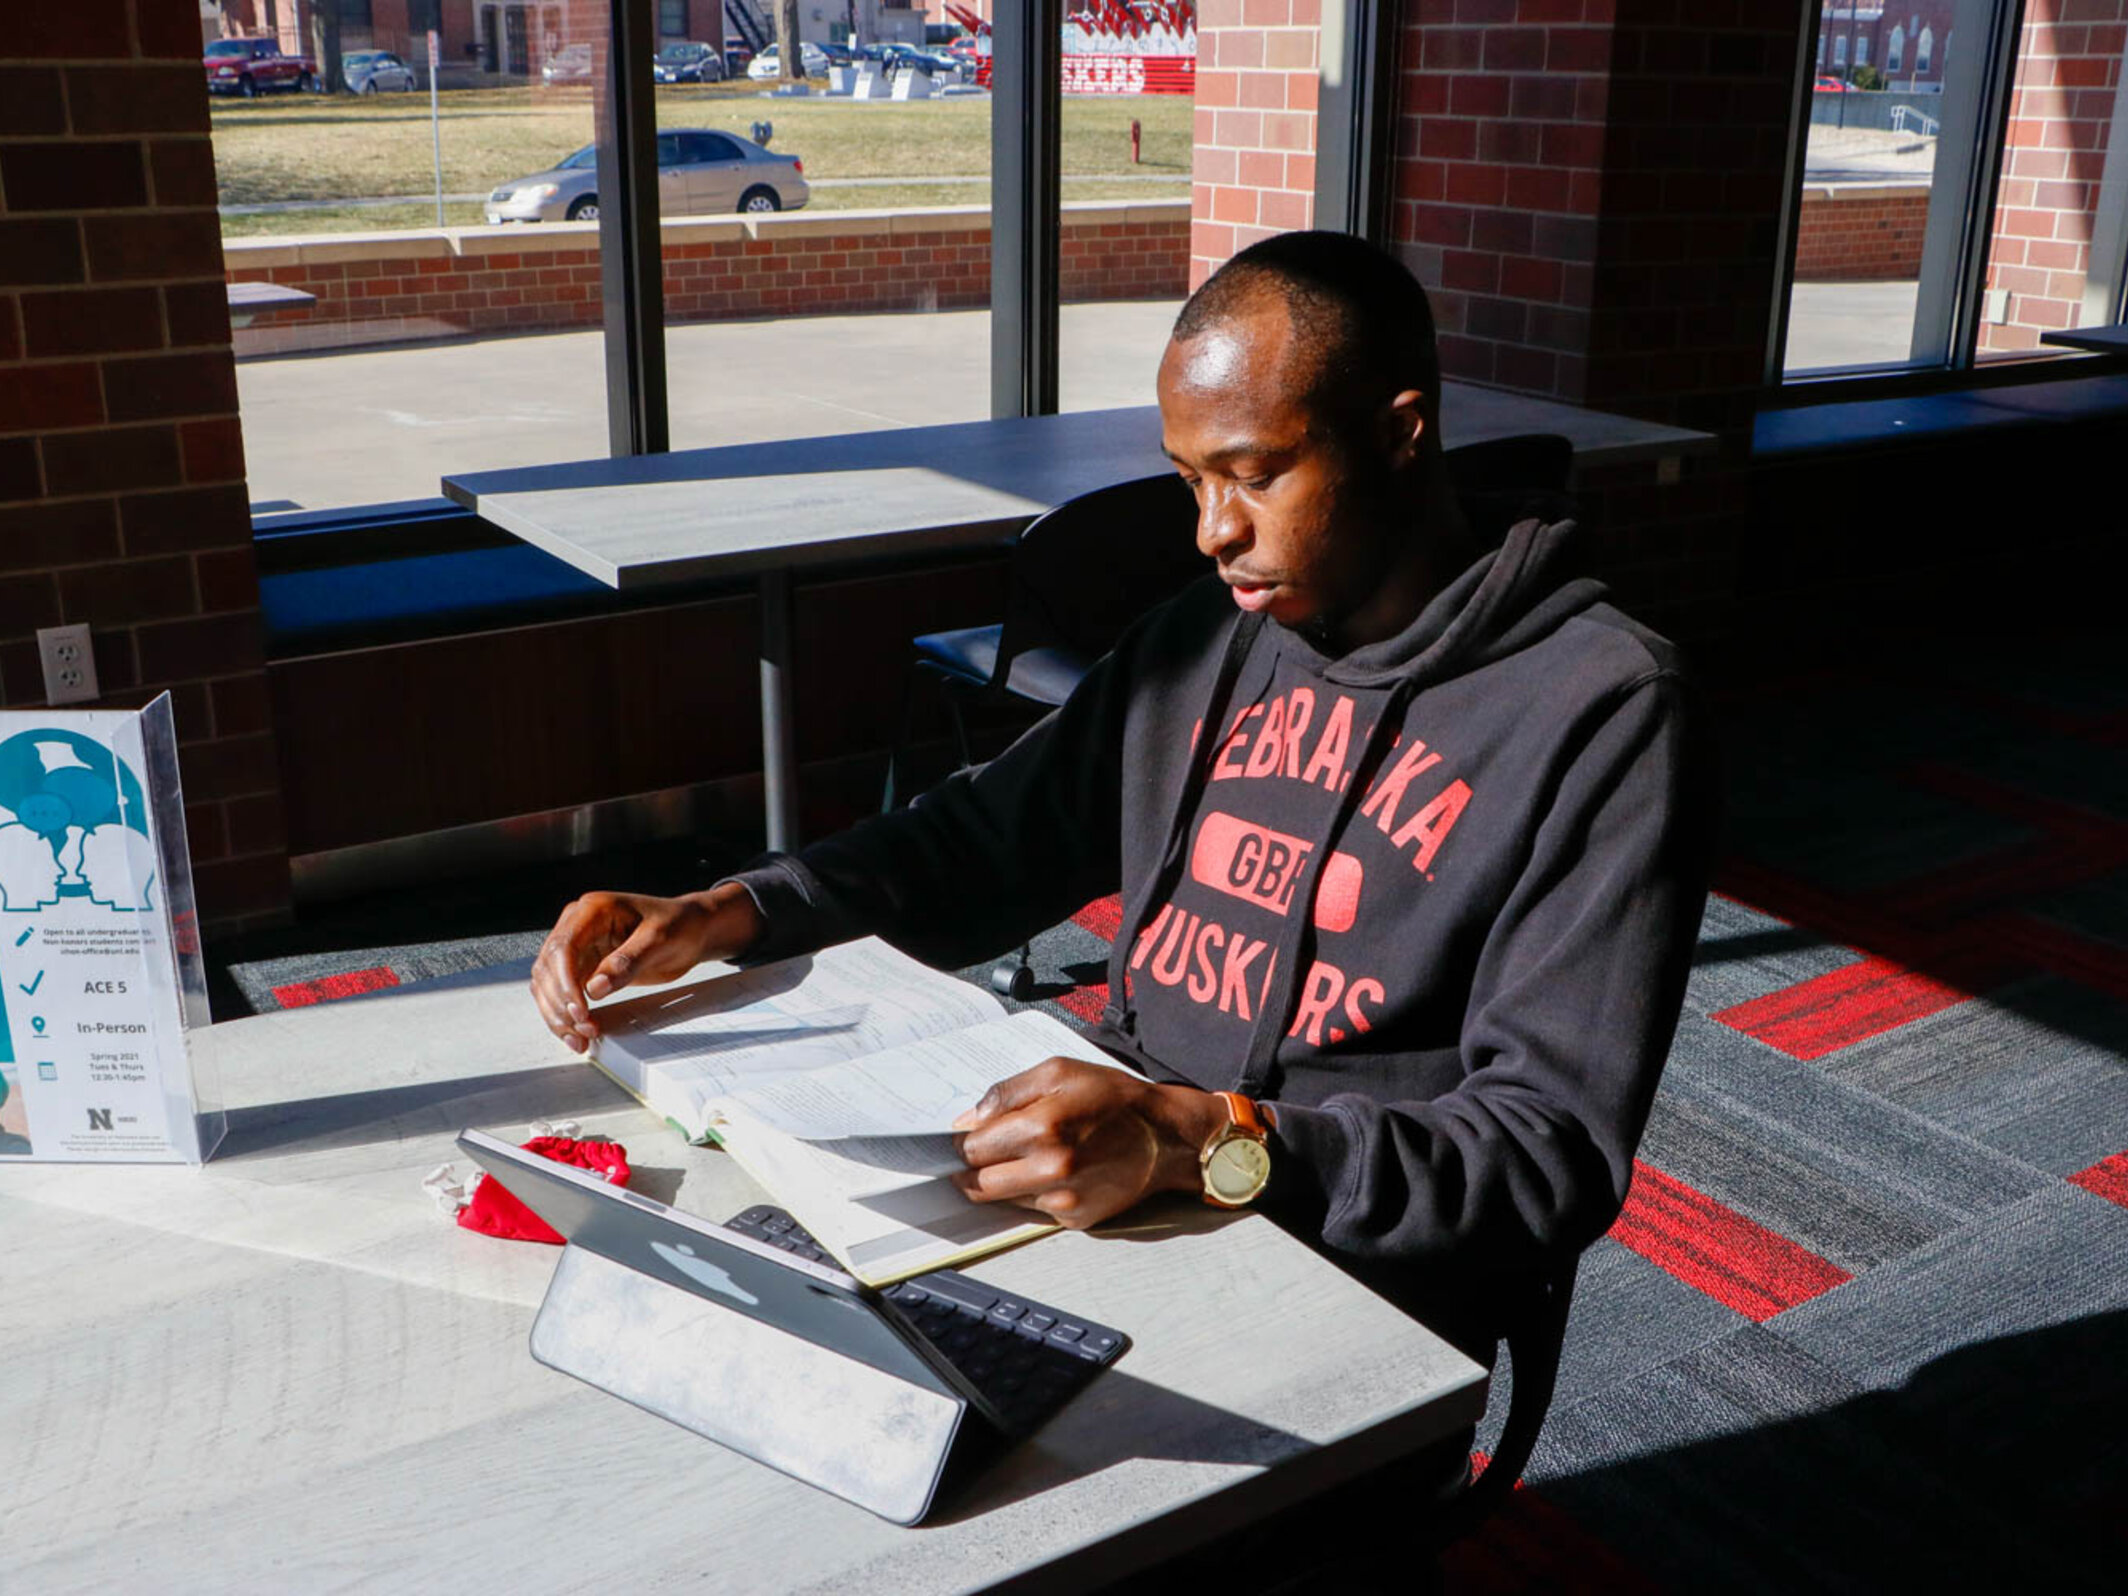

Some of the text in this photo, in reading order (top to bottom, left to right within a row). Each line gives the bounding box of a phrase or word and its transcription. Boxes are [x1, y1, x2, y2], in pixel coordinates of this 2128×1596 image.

[1190, 687, 1474, 874] EBRAKA
[43, 928, 64, 937] Open
[65, 928, 74, 936] to
[76, 927, 86, 936] all
[89, 938, 123, 946] students
[1130, 903, 1386, 1047] USKRS
[84, 981, 128, 994] ACE 5
[77, 1022, 147, 1034] In-Person
[90, 1052, 139, 1063] Spring 2021
[89, 1062, 144, 1071] Tues & Thurs
[87, 1108, 114, 1130] N
